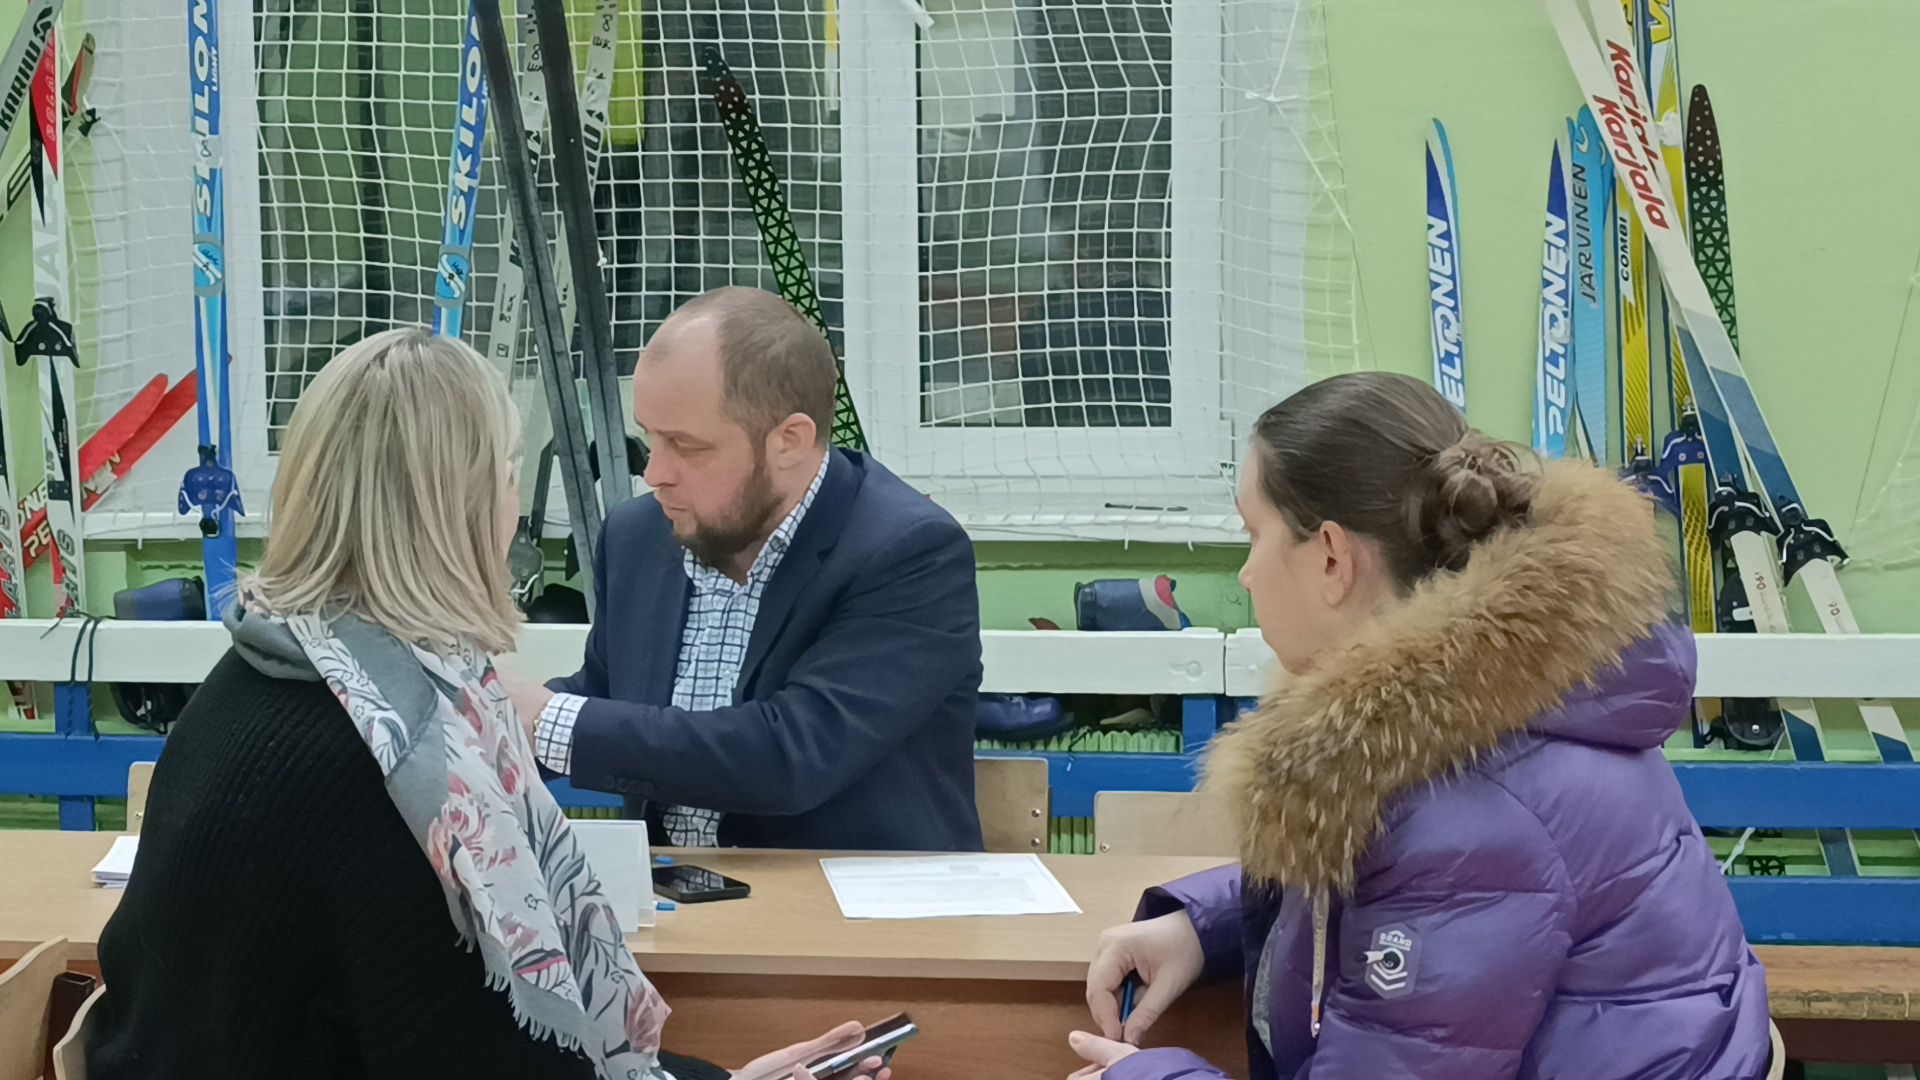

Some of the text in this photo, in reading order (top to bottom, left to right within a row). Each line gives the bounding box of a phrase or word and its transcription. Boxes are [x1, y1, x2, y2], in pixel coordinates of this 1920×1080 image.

[1593, 94, 1670, 230] Karjala
[1606, 39, 1660, 182] Karjal
[1427, 215, 1465, 408] ELTONEN
[1619, 216, 1631, 282] COMBI
[1542, 210, 1570, 437] PELTONEN
